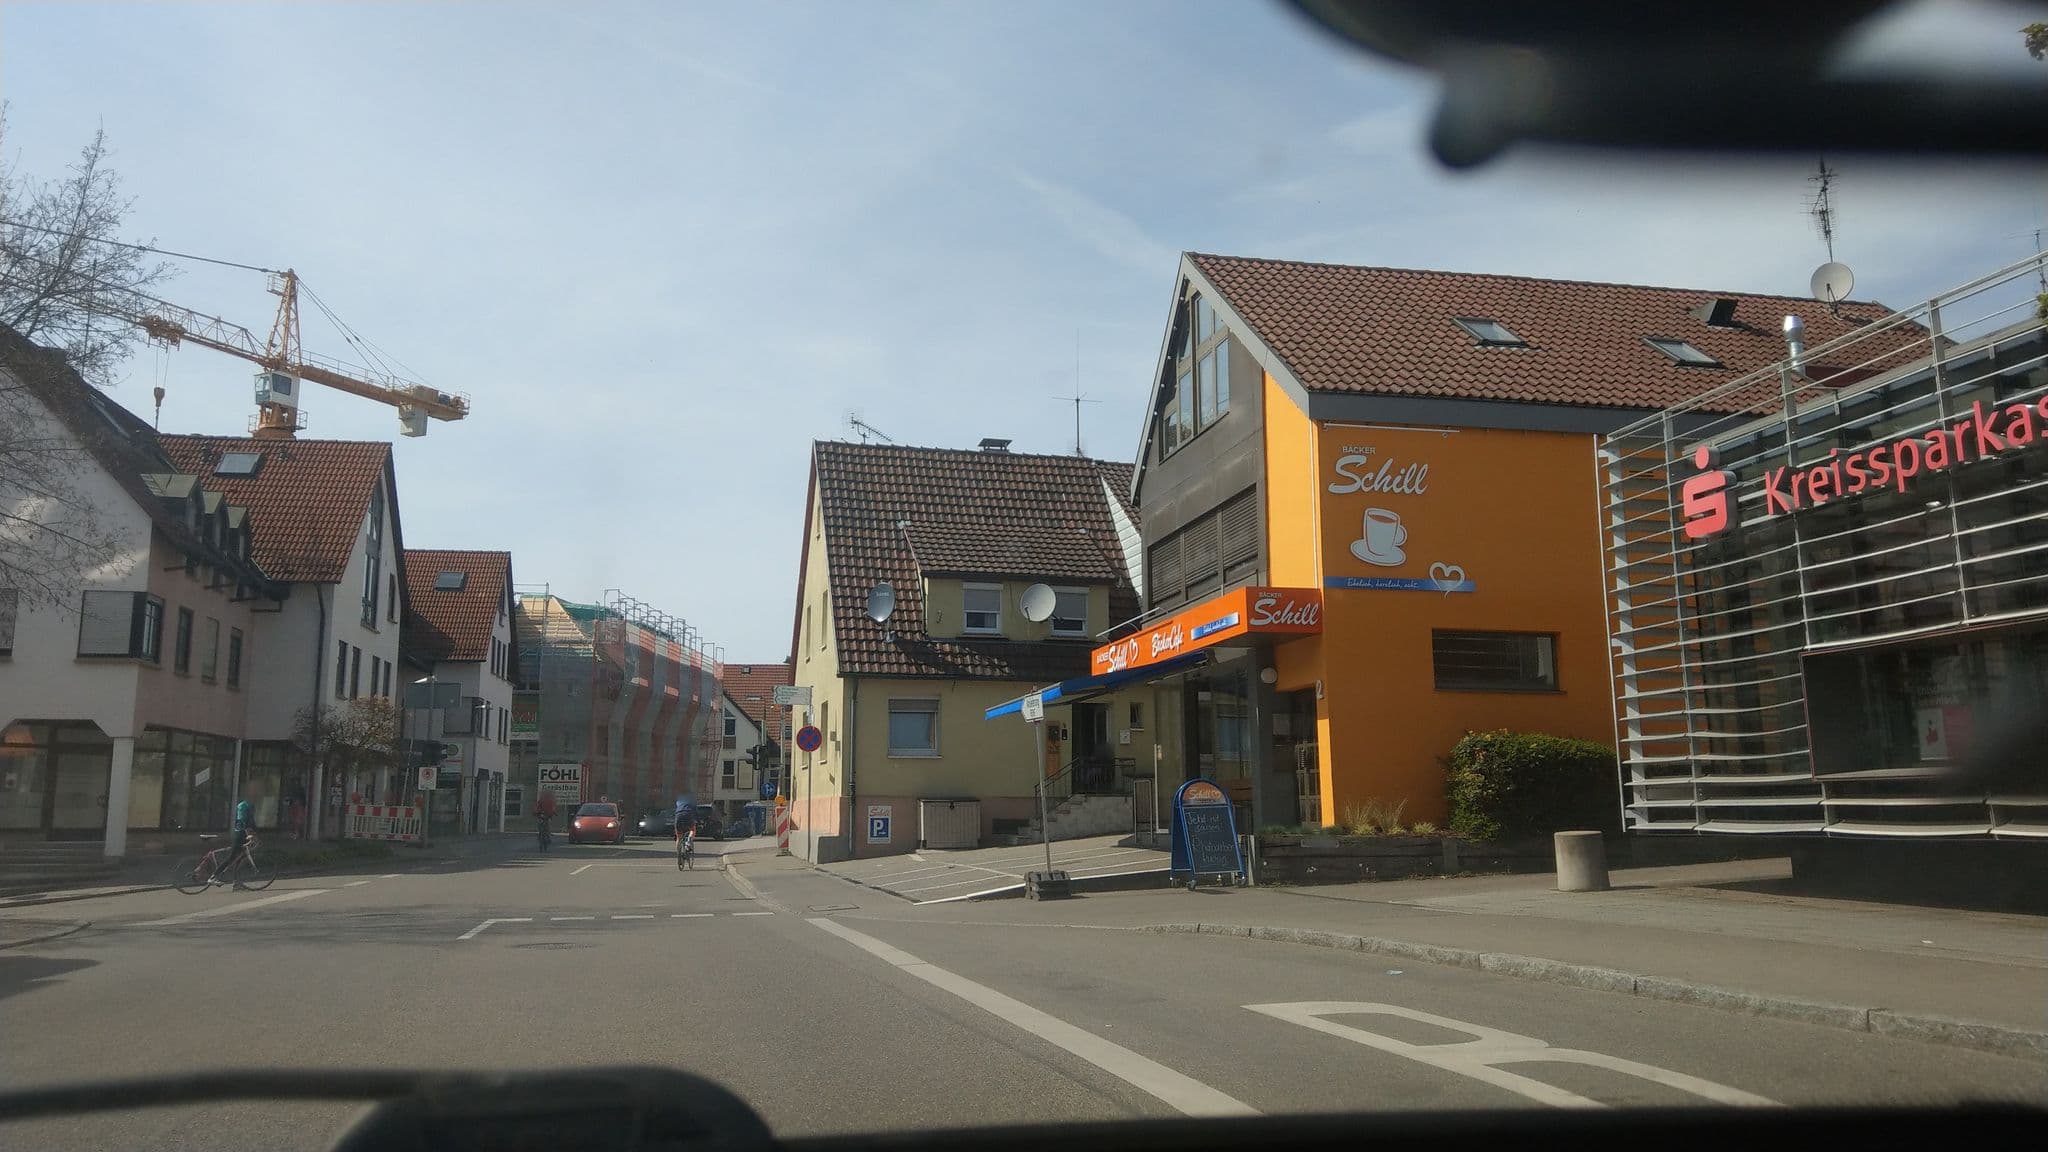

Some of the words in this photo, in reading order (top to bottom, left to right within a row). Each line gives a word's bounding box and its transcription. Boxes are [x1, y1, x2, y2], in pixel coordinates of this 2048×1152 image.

[1328, 454, 1428, 494] Schill
[1250, 598, 1319, 625] Schill
[540, 765, 580, 780] FÖHL
[873, 819, 884, 836] P
